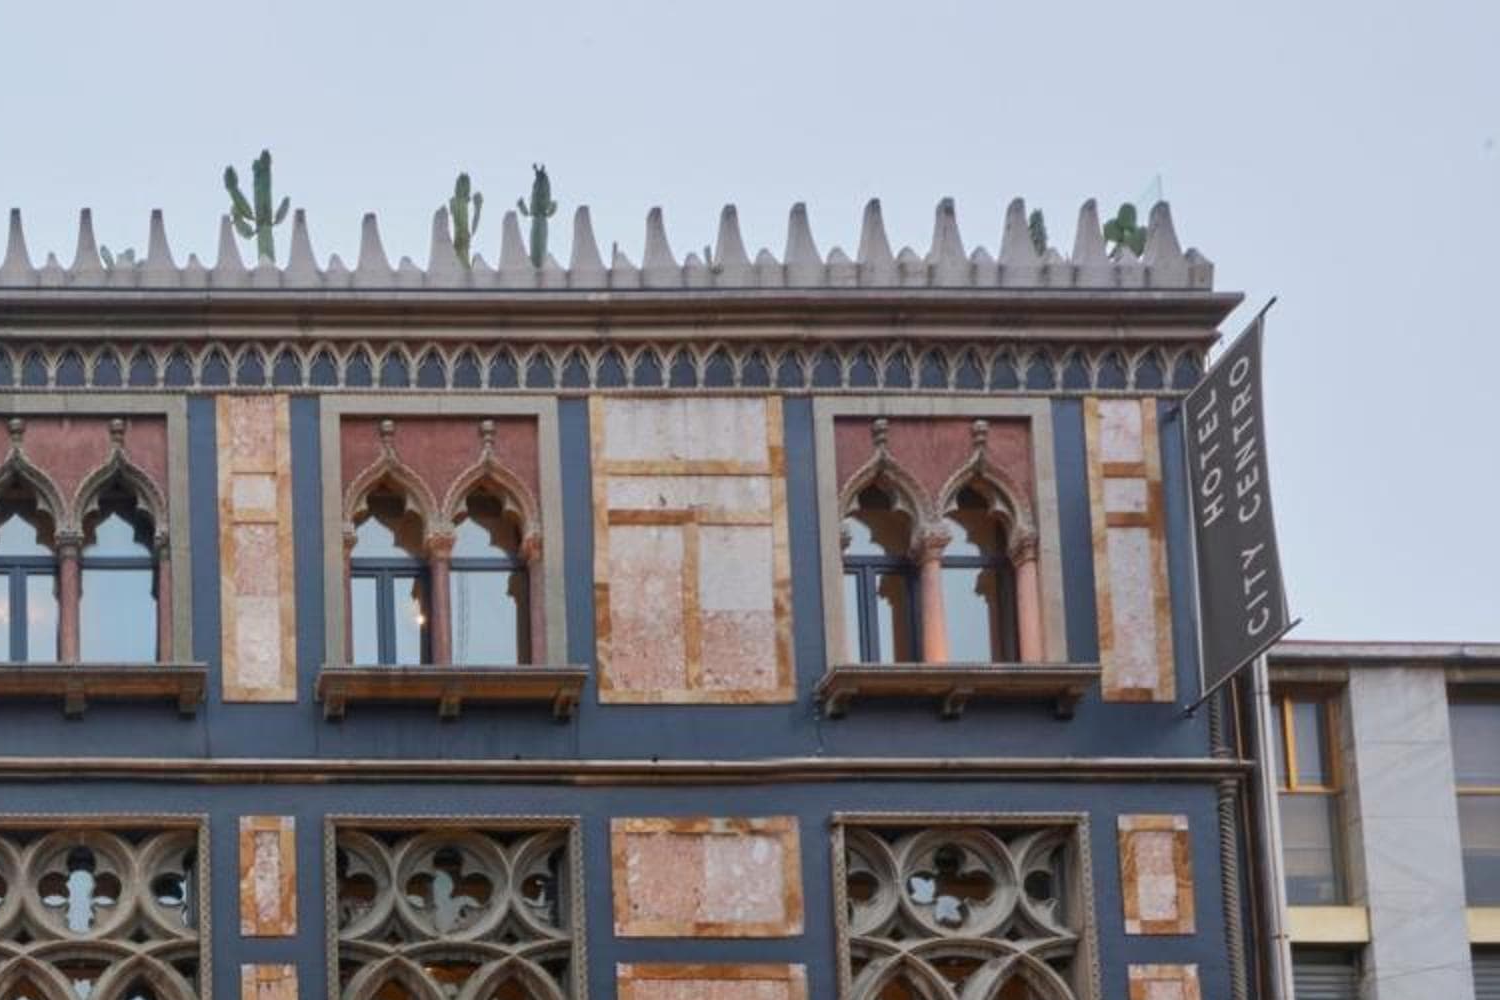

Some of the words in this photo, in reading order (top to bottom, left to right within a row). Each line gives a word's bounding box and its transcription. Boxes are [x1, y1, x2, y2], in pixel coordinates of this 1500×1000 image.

[1197, 389, 1225, 528] HOTEL
[1228, 355, 1262, 523] CENTRO
[1240, 542, 1269, 636] CITY
